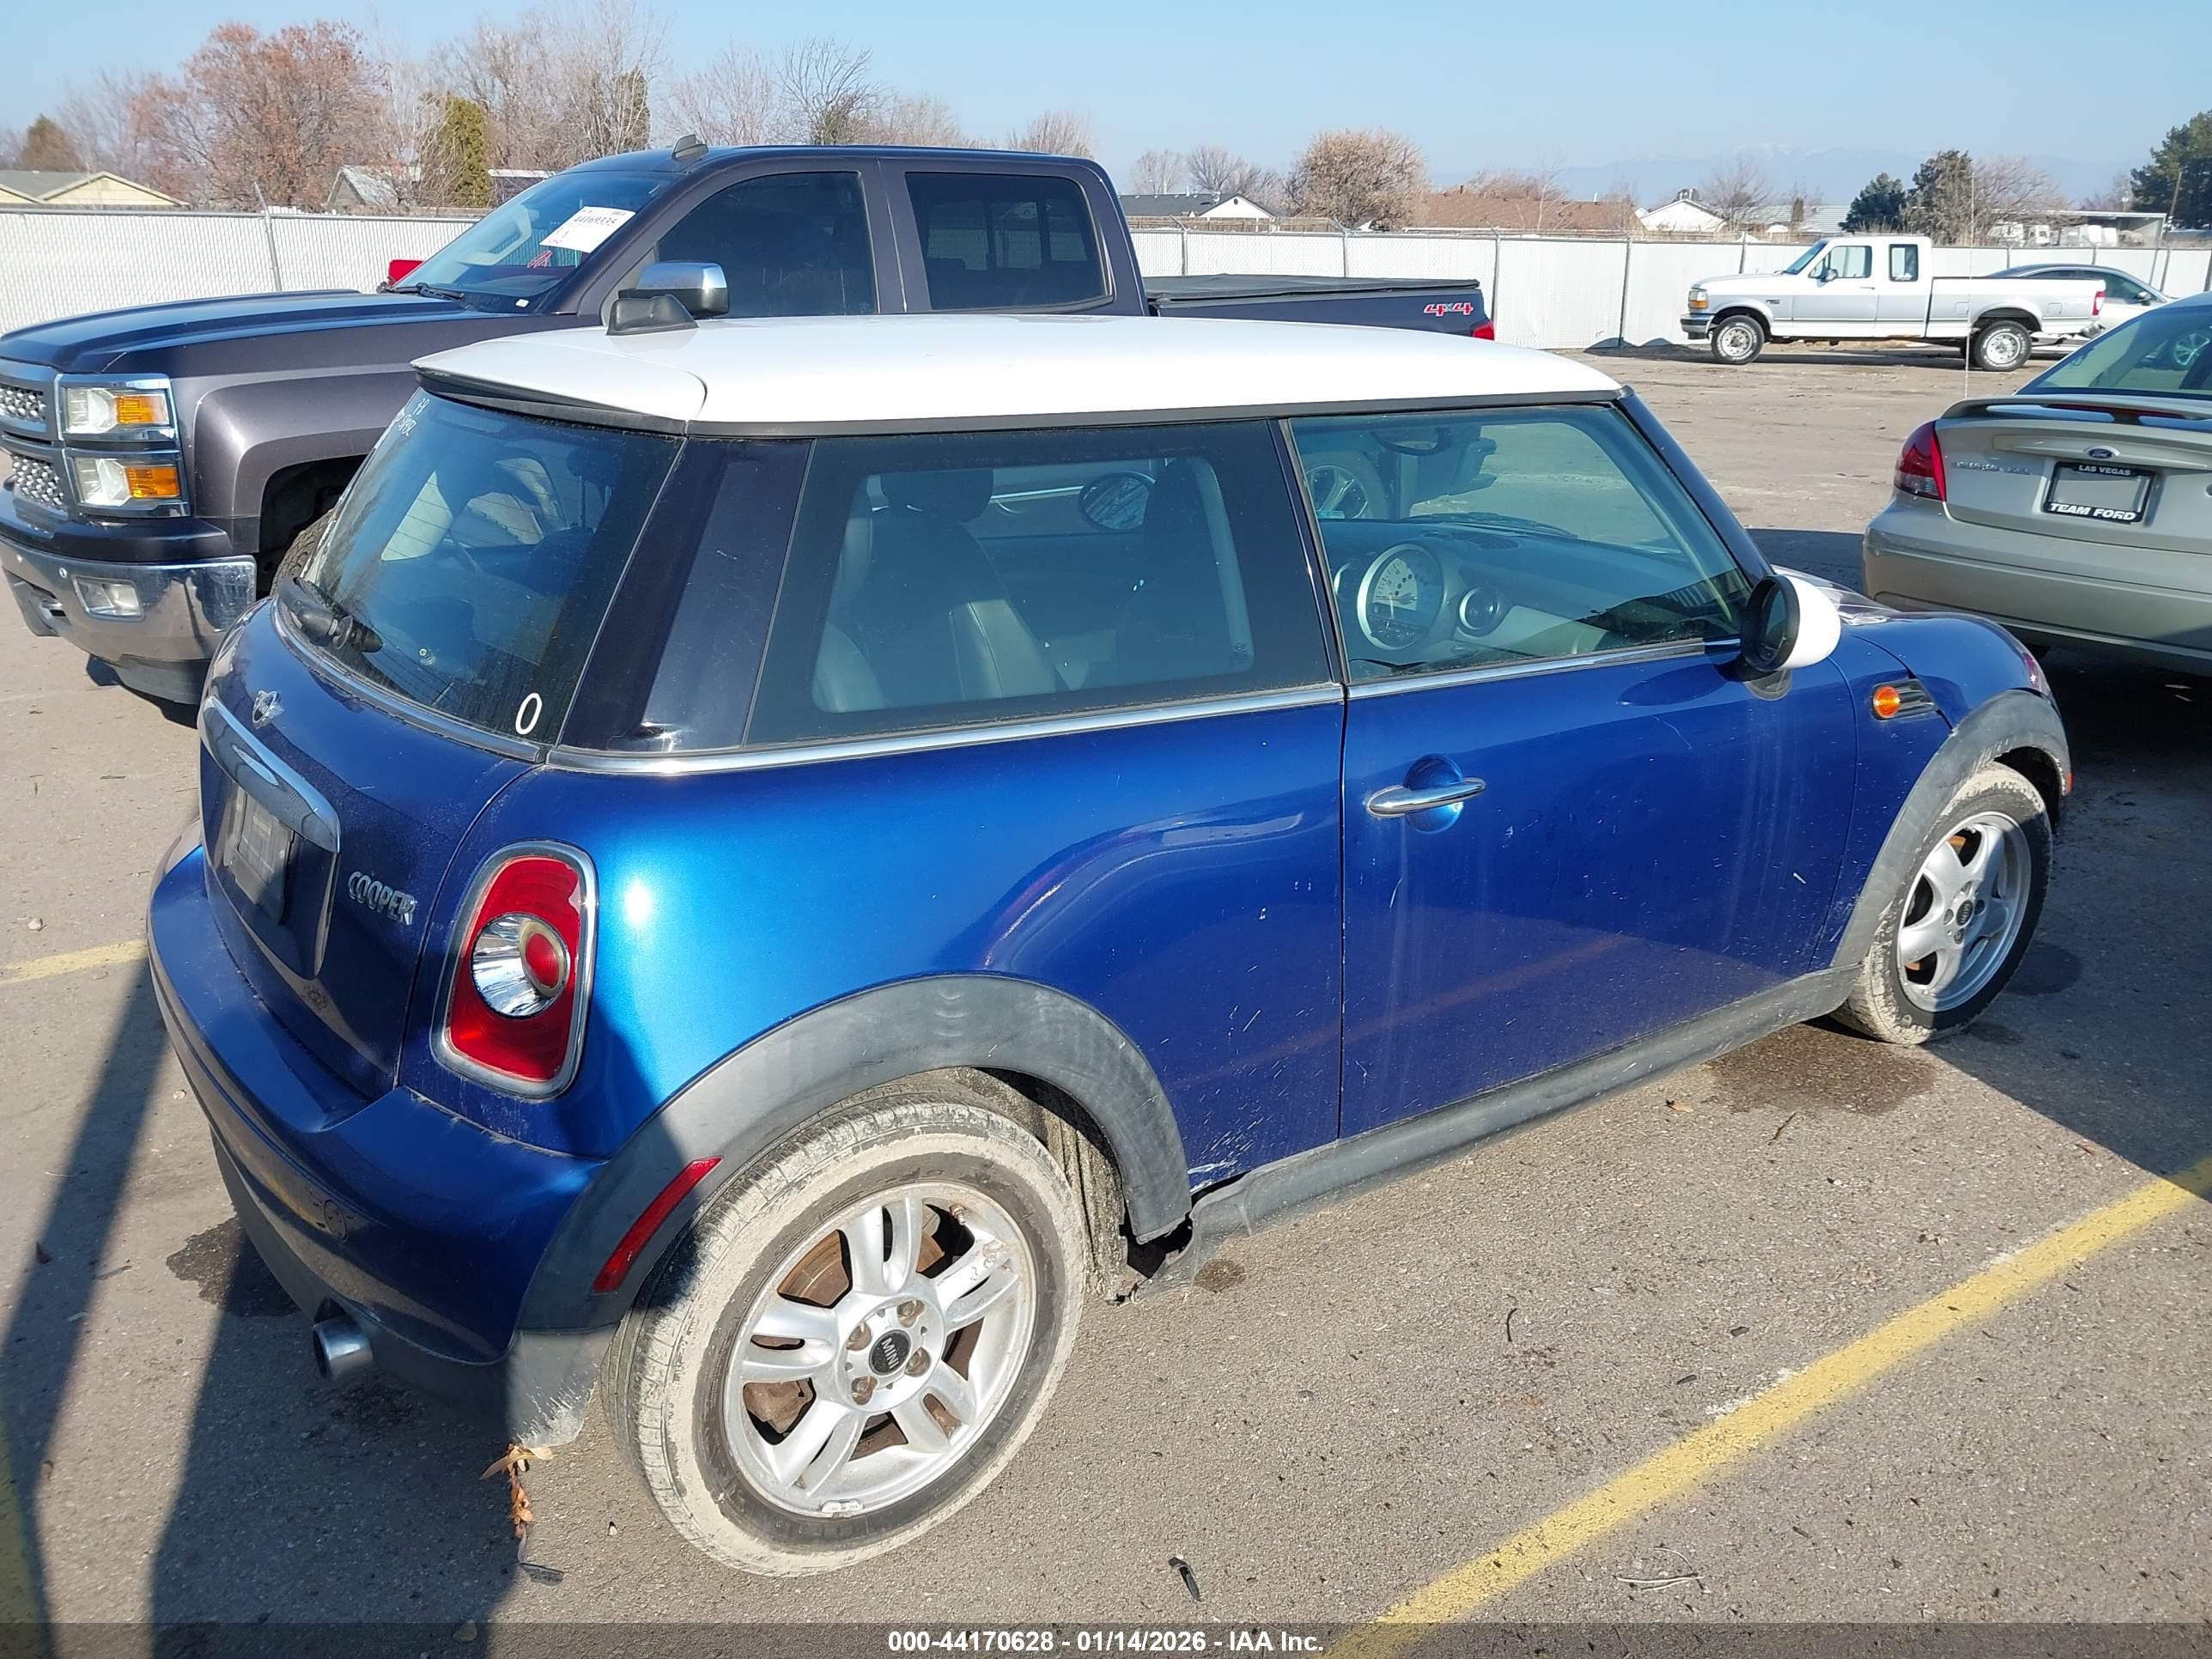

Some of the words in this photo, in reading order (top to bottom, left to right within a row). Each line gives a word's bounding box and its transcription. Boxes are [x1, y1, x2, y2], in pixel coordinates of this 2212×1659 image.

[2099, 466, 2131, 476] VEGAS
[2050, 502, 2091, 515] TEAM
[2093, 507, 2136, 520] FORD
[348, 871, 416, 926] COOPER
[881, 1337, 900, 1369] MINI
